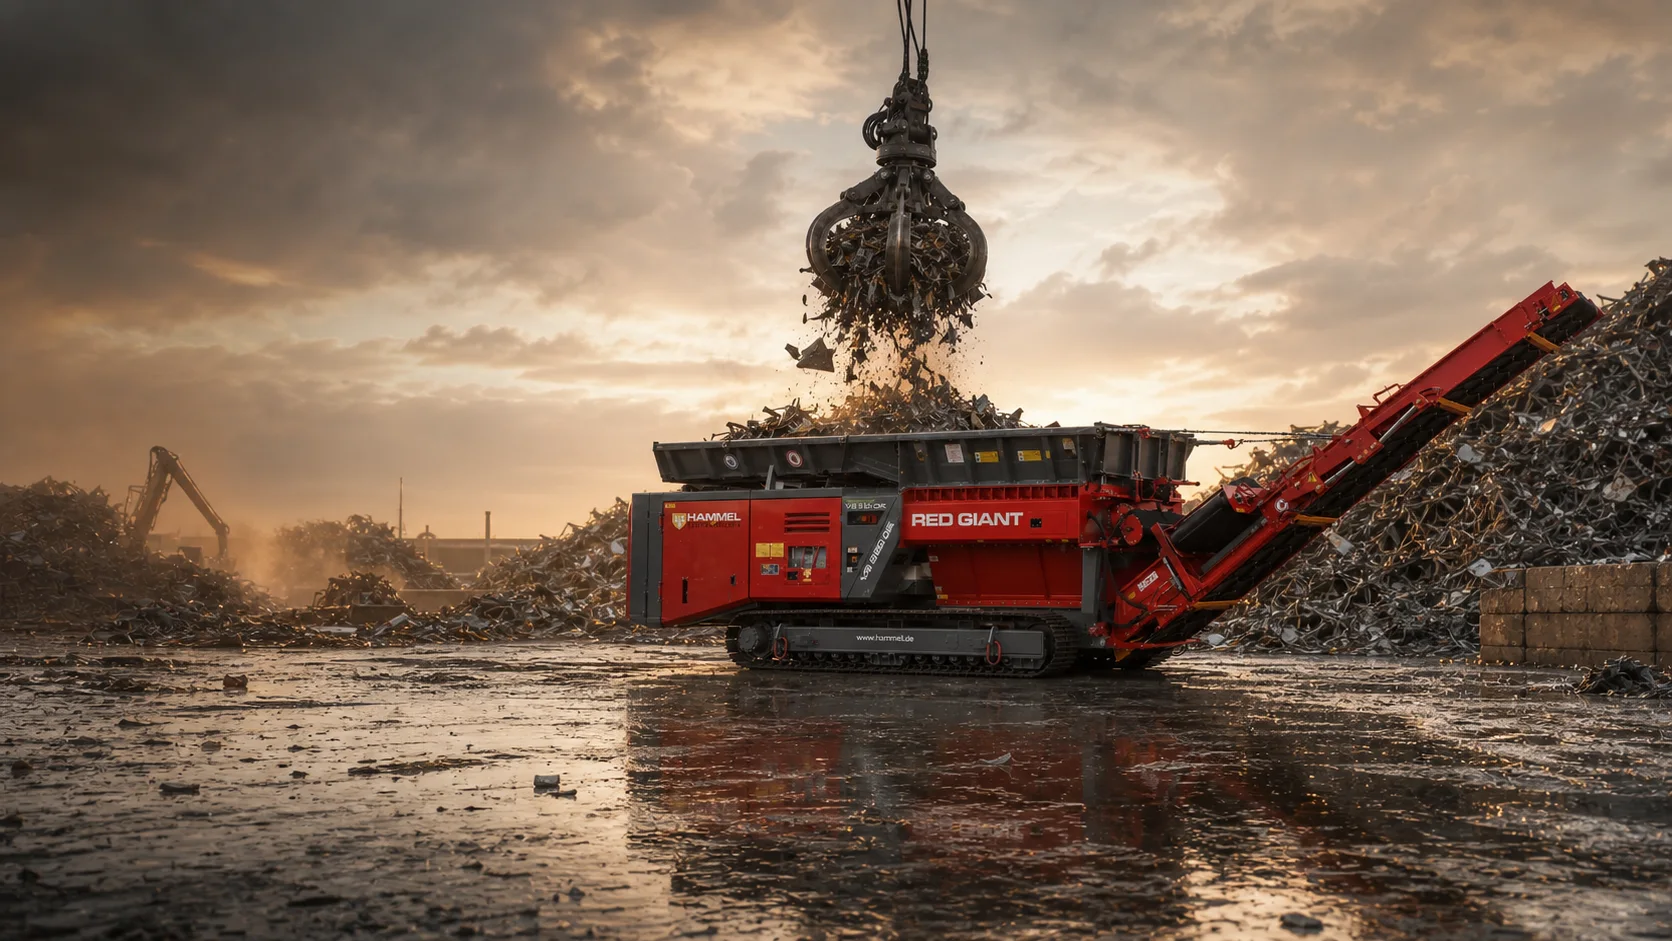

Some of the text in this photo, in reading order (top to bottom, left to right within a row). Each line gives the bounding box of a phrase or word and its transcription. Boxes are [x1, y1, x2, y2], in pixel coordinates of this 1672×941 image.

[687, 512, 741, 521] HAMMEL
[911, 512, 1024, 527] RED GIANT
